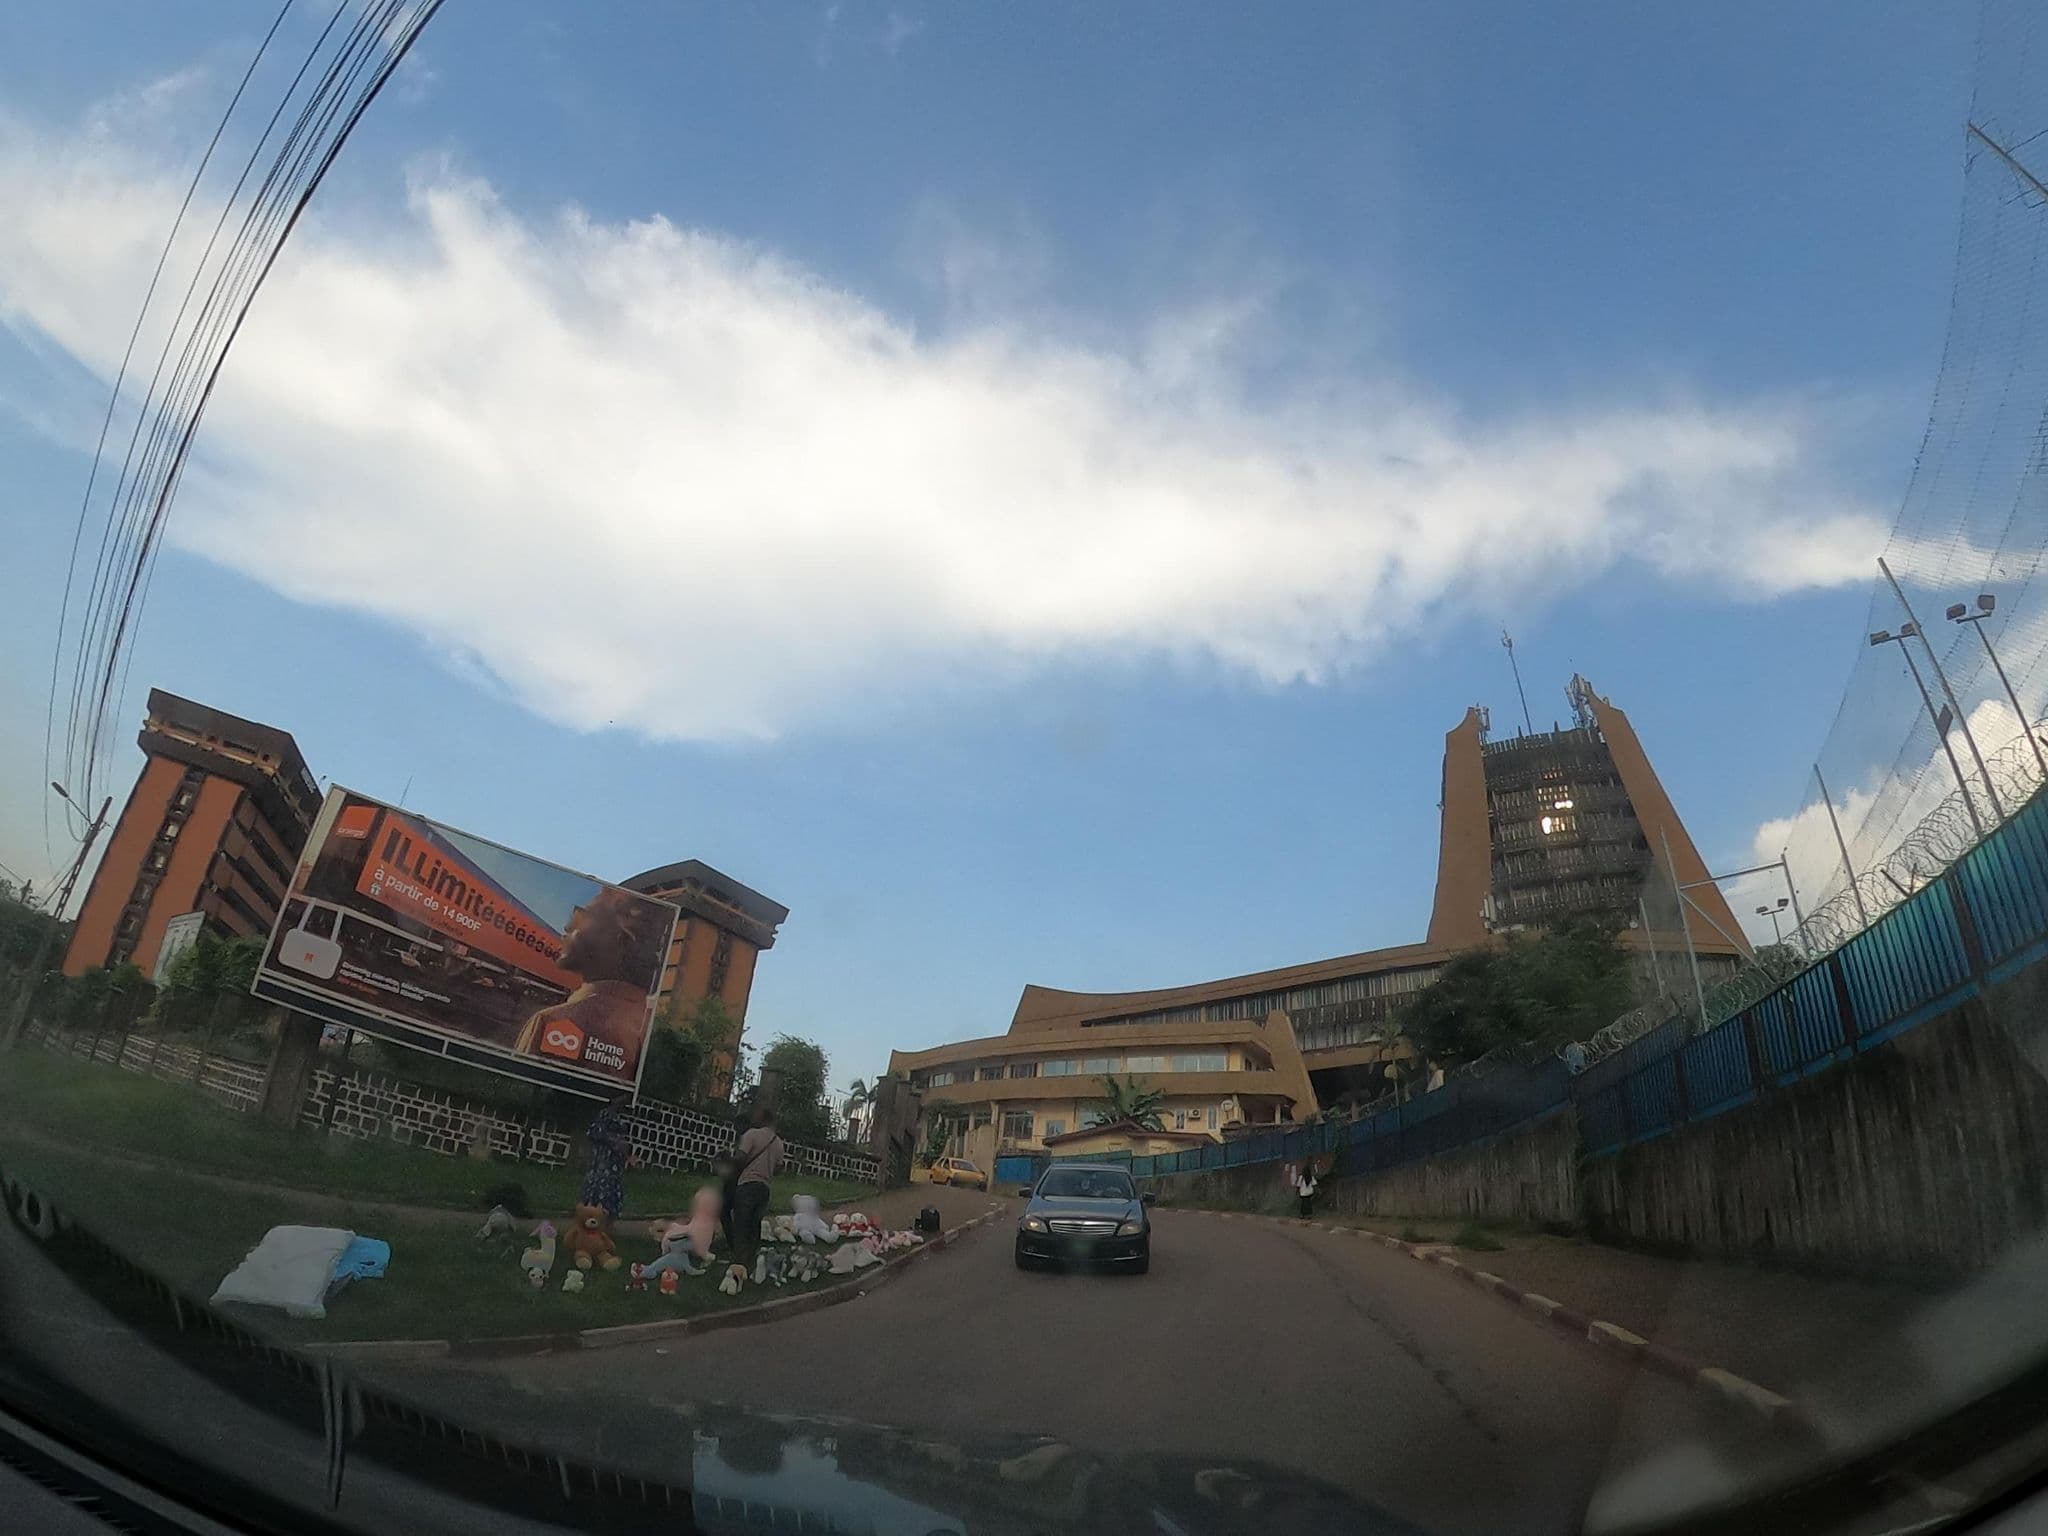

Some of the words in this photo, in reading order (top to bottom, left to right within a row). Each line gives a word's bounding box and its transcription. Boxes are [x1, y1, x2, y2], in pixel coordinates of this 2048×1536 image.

[374, 864, 384, 881] à
[385, 875, 422, 901] partir
[424, 896, 439, 911] de
[588, 1036, 624, 1056] Home
[585, 1048, 626, 1070] Infinity
